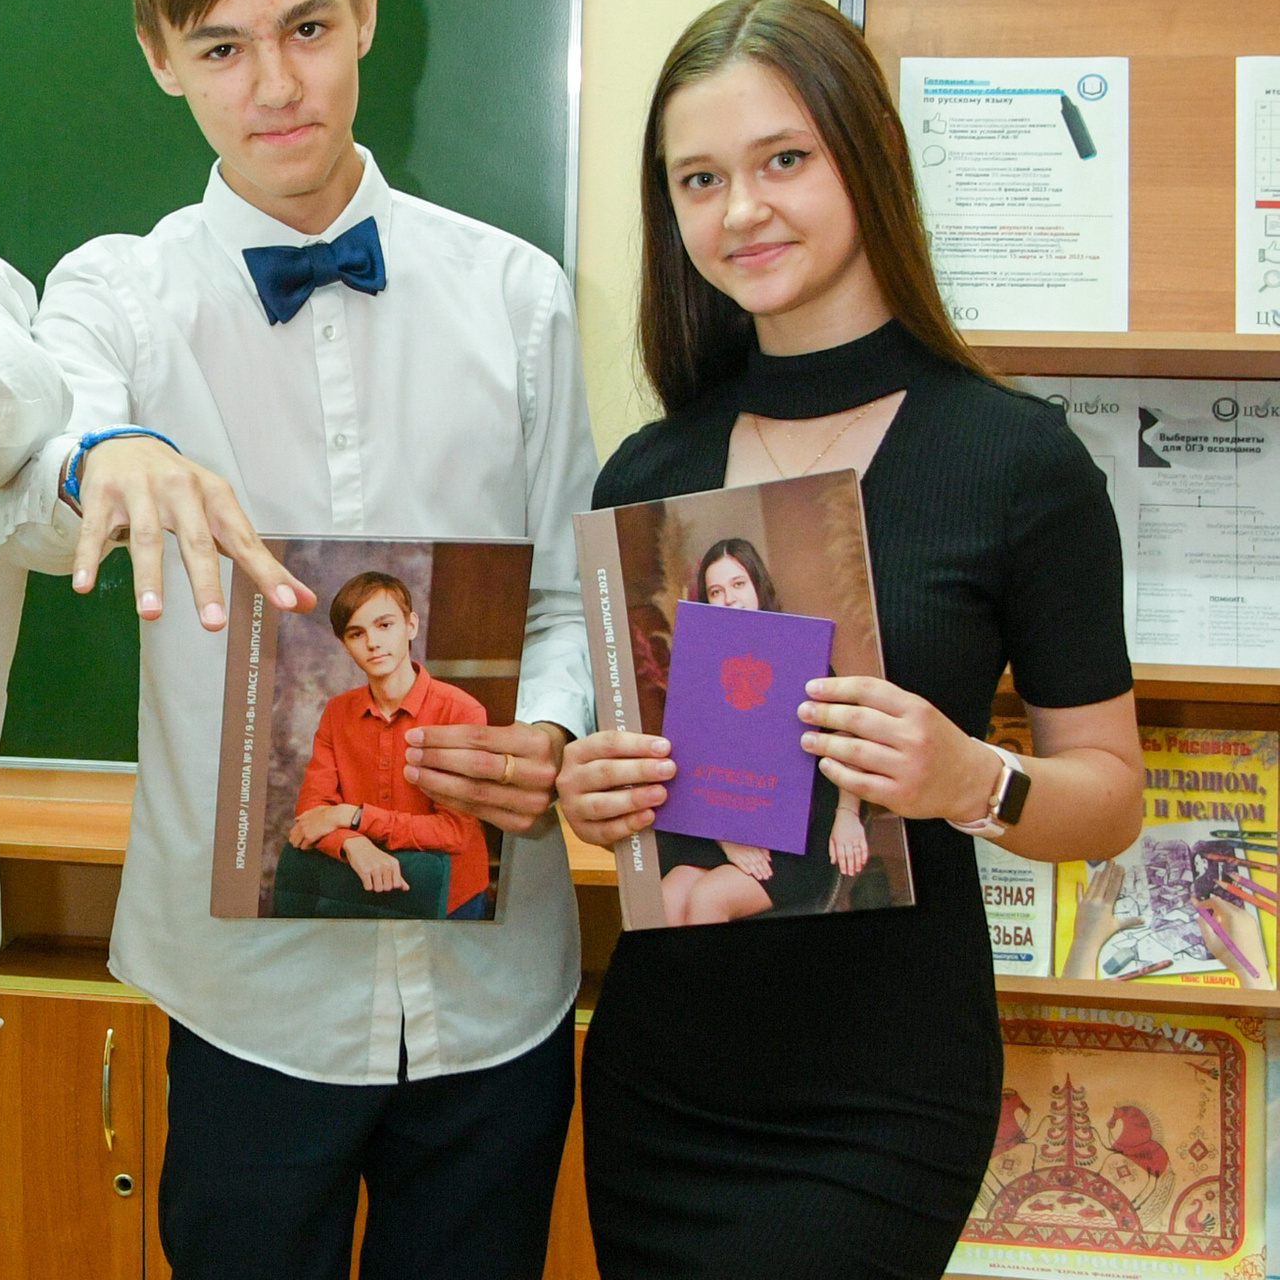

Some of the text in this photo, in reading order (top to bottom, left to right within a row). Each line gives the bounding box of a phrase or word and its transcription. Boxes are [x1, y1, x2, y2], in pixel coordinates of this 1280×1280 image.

[938, 97, 981, 105] русскому
[985, 97, 1013, 105] языку
[953, 306, 979, 320] КО
[1159, 433, 1265, 444] Выберите предметы
[1185, 444, 1204, 452] ОГЭ
[1207, 445, 1261, 453] осознанно
[597, 568, 609, 595] 2023
[253, 593, 264, 618] 2023
[601, 596, 615, 643] ВЫПУСК
[250, 620, 261, 663] ВЫПУСК
[607, 650, 620, 688] КЛАСС
[247, 671, 258, 705] КЛАСС
[615, 709, 624, 717] 9
[244, 739, 253, 751] 95
[1165, 732, 1251, 756] Рисовать
[243, 752, 252, 764] №
[240, 765, 252, 803] ШКОЛА
[693, 765, 778, 789] АТТЕСТАТ
[1177, 800, 1266, 822] мелком
[235, 809, 249, 869] КРАСНОДАР
[631, 832, 643, 871] КРАСН
[983, 885, 1035, 906] ЕЗНАЯ
[992, 925, 1034, 946] ЗЬБА
